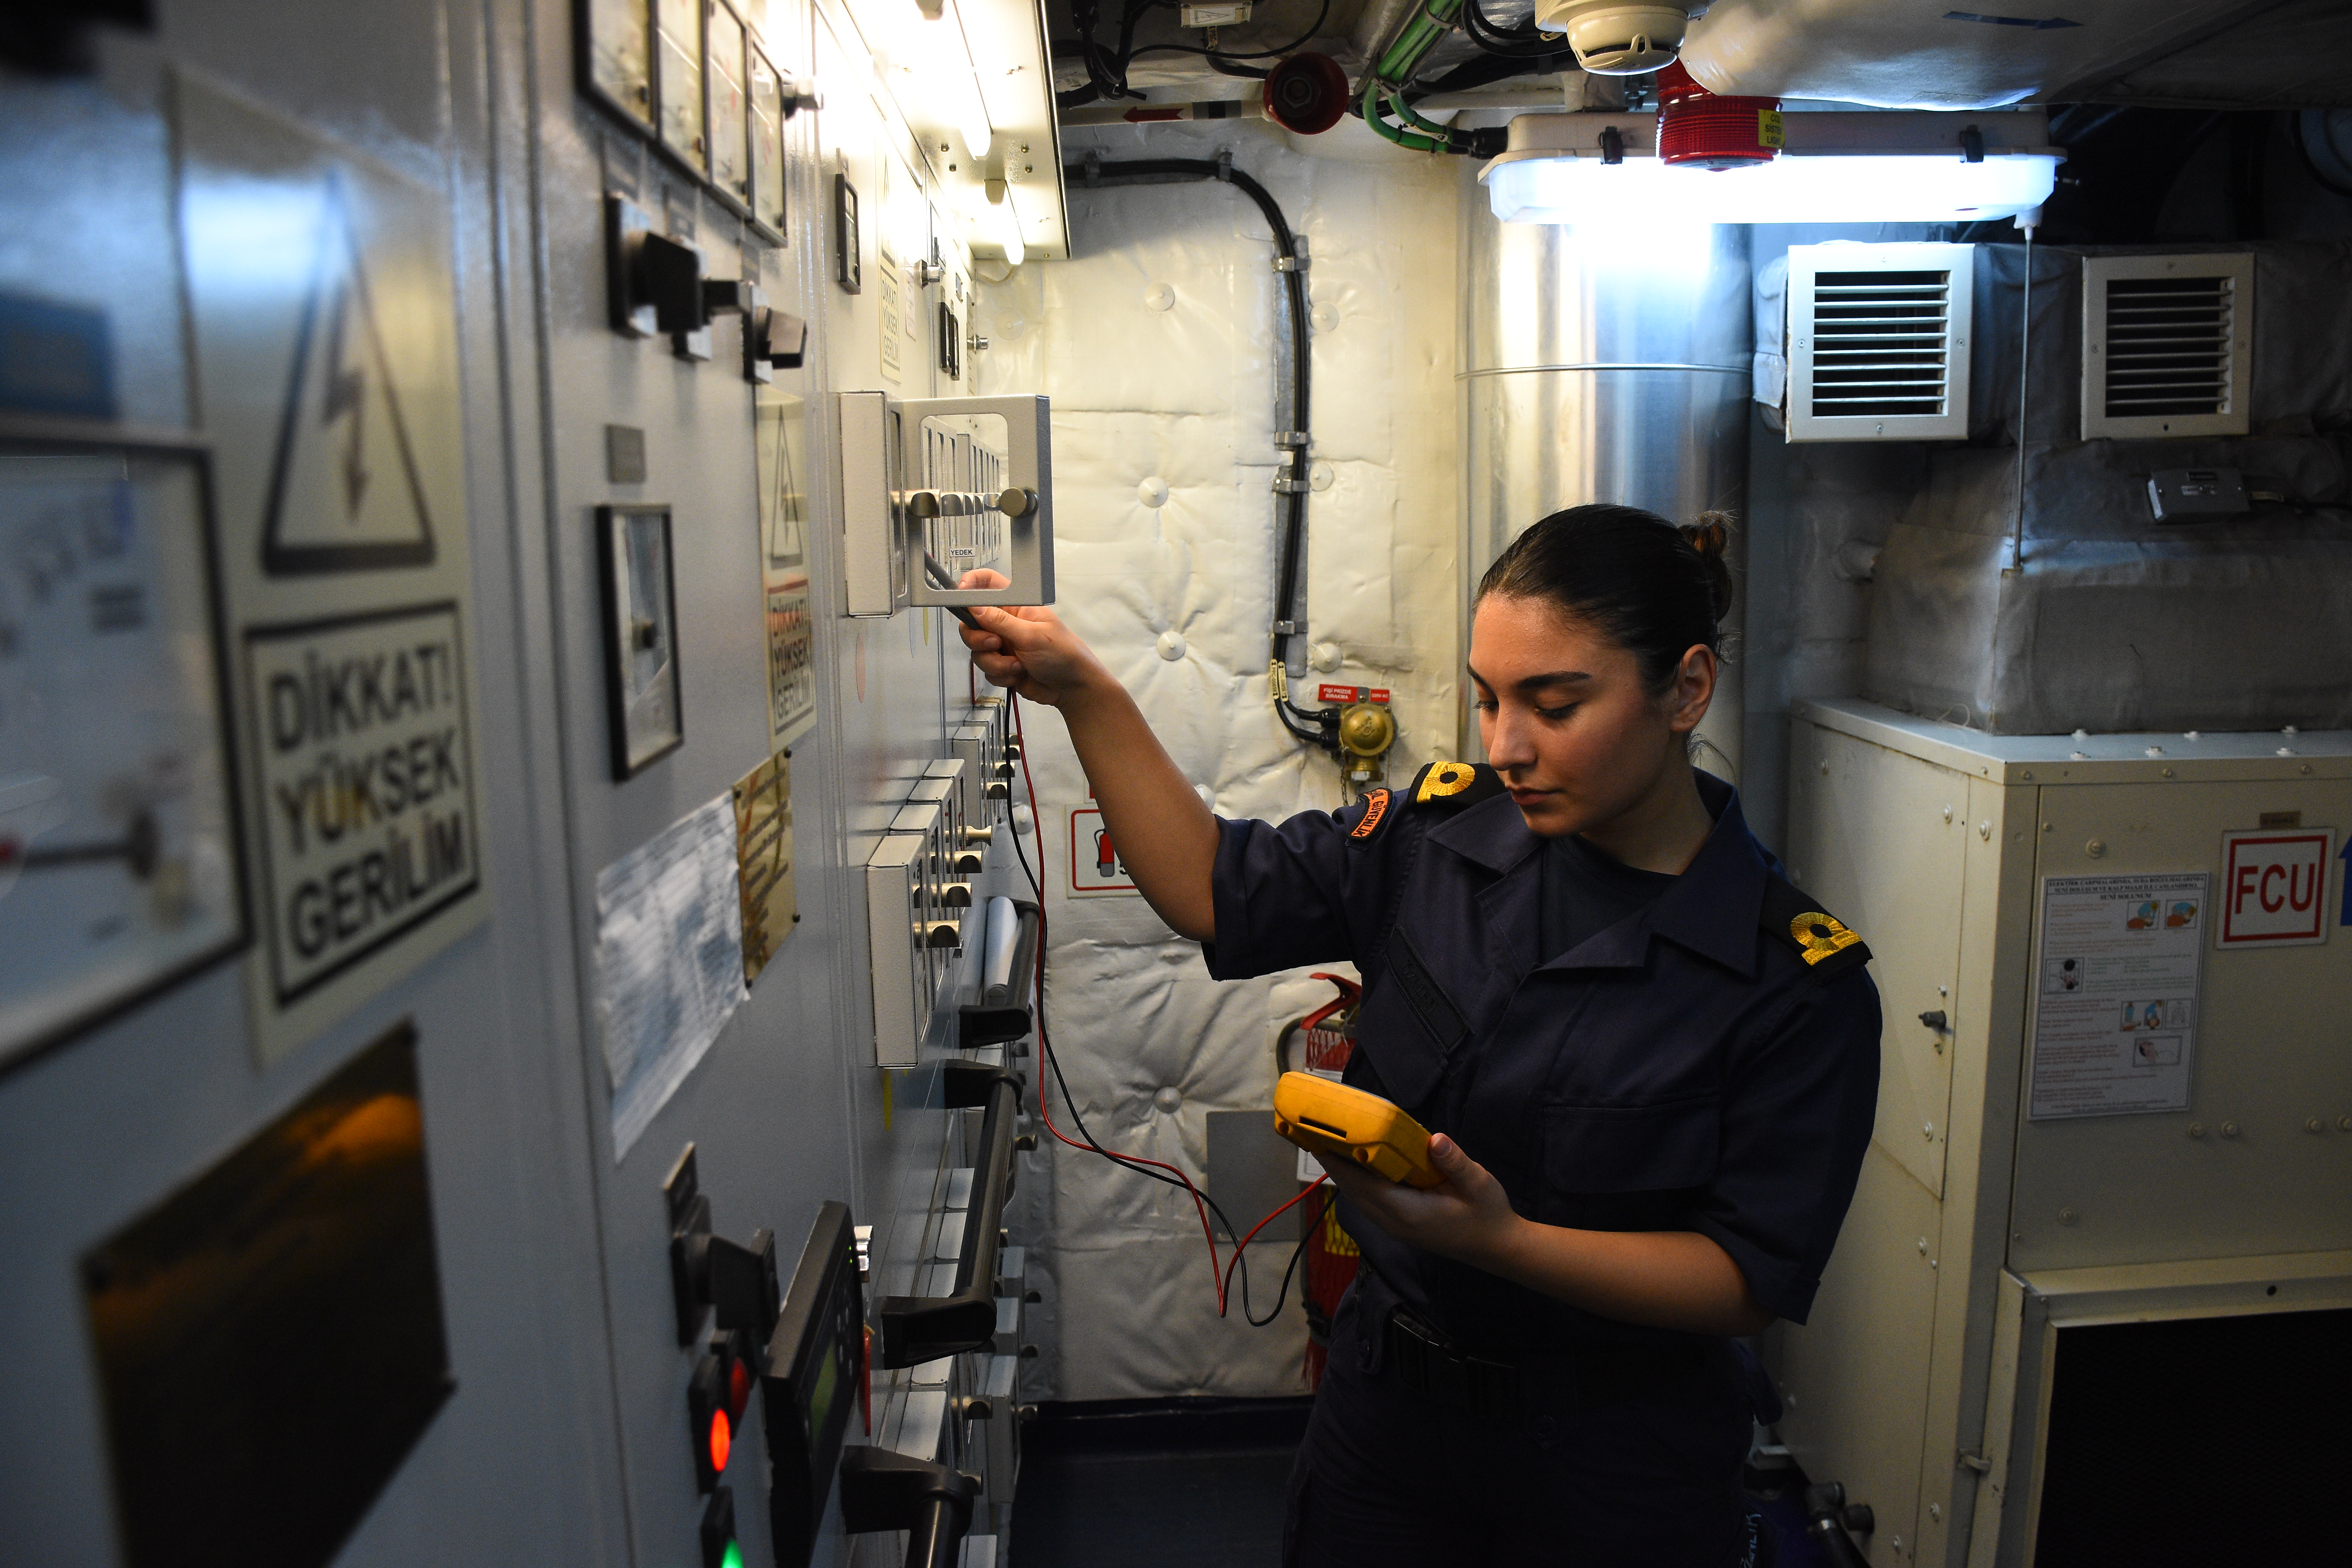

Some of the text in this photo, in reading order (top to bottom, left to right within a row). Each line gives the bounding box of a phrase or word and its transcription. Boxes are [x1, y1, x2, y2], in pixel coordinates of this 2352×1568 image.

[882, 278, 897, 311] DİKKAT!
[883, 306, 898, 337] YÜKSEK
[884, 335, 898, 363] GERİLİM
[773, 598, 808, 637] DİKKAT!
[774, 637, 809, 678] YÜKSEK
[268, 641, 453, 752] DİKKAT!
[777, 674, 810, 719] GERİLİM
[276, 728, 459, 854] YÜKSEK
[1353, 801, 1387, 837] GÜVENLİK
[290, 810, 463, 959] GERİLİM
[2235, 863, 2315, 915] FCU
